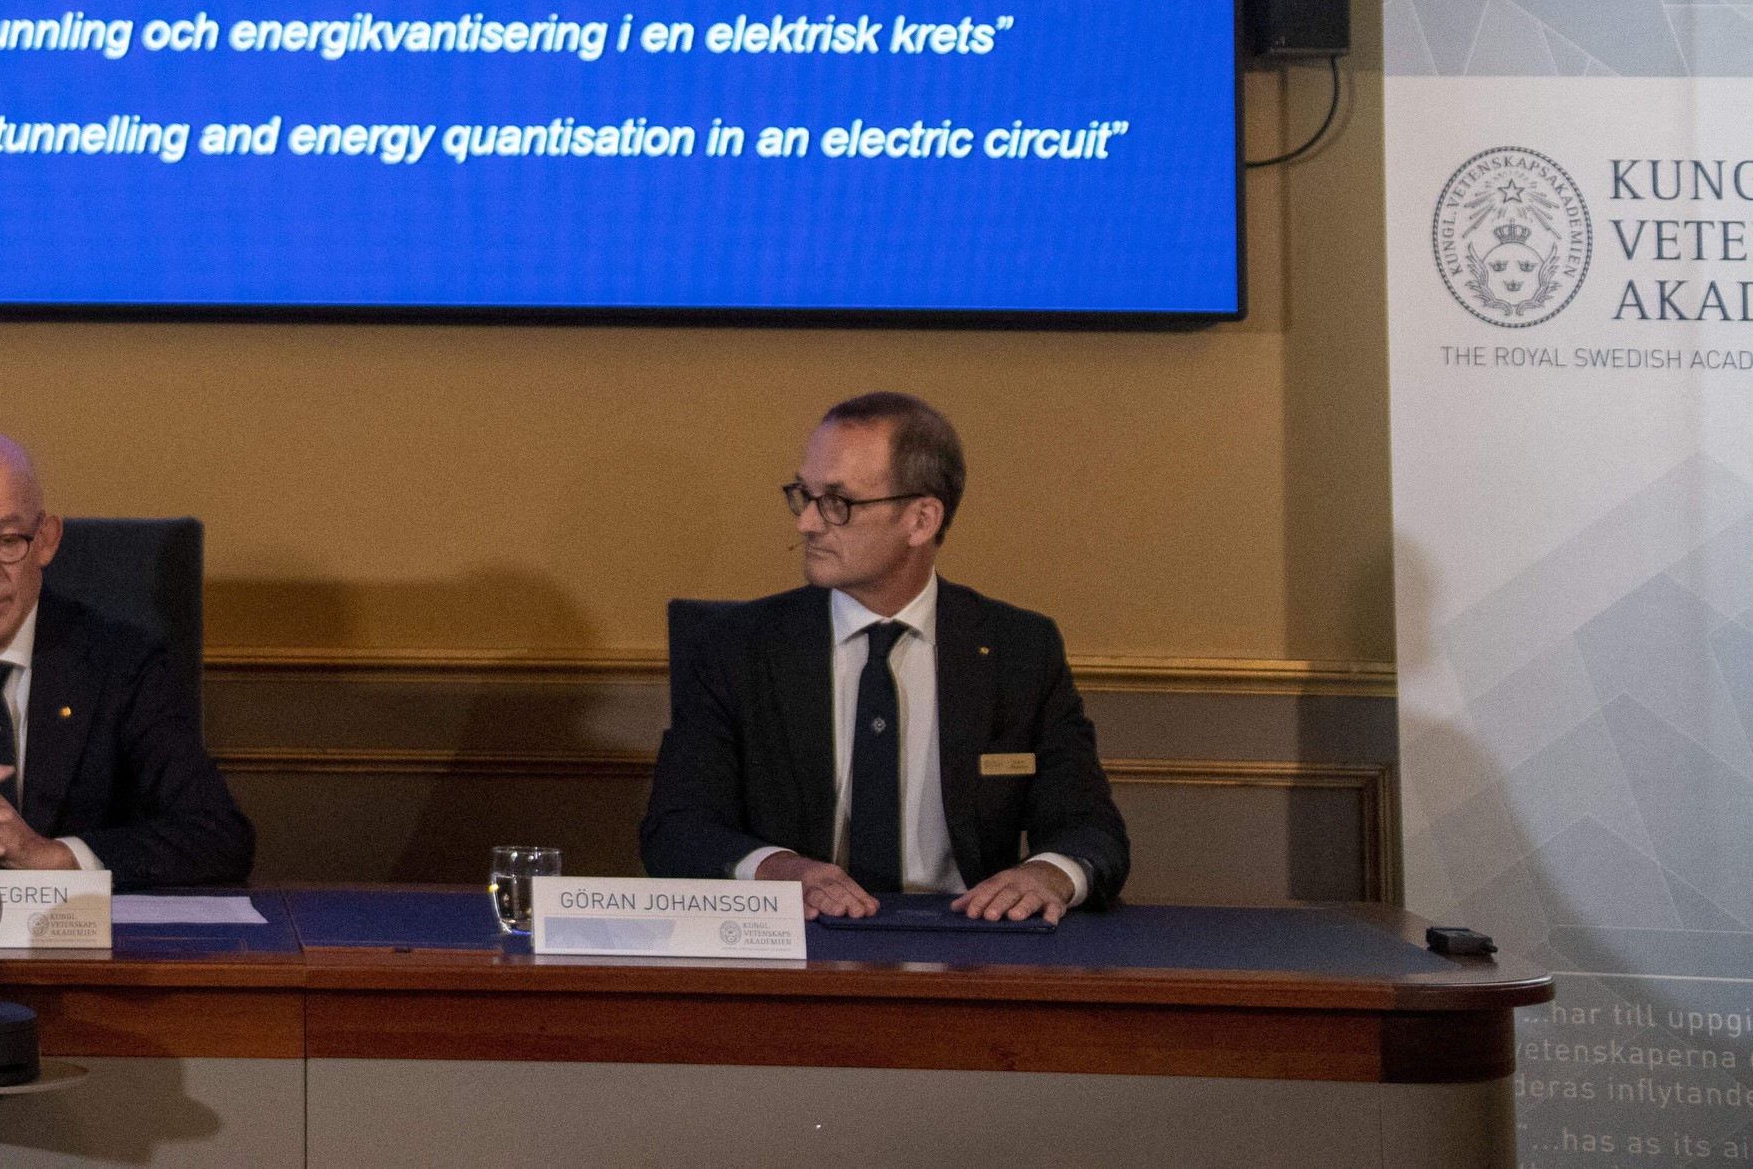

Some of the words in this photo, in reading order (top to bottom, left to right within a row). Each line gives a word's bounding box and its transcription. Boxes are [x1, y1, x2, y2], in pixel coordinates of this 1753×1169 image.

[142, 11, 220, 51] och
[229, 11, 609, 62] energikvantisering
[617, 13, 634, 52] i
[641, 21, 695, 53] en
[705, 13, 884, 54] elektrisk
[199, 115, 283, 155] and
[288, 123, 437, 165] energy
[443, 116, 696, 164] quantisation
[706, 117, 745, 157] in
[756, 126, 810, 158] an
[821, 118, 975, 159] electric
[1446, 154, 1585, 280] VETENSKAPSAKADEMIEN
[1440, 345, 1486, 368] THE
[1494, 345, 1568, 369] ROYAL
[1574, 347, 1683, 370] SWEDISH
[559, 888, 637, 911] GÖRAN
[643, 893, 780, 914] JOHANSSON
[1612, 1002, 1657, 1028] till
[1668, 1007, 1752, 1039] uppgi
[1627, 1134, 1662, 1156] as
[1673, 1132, 1712, 1158] its
